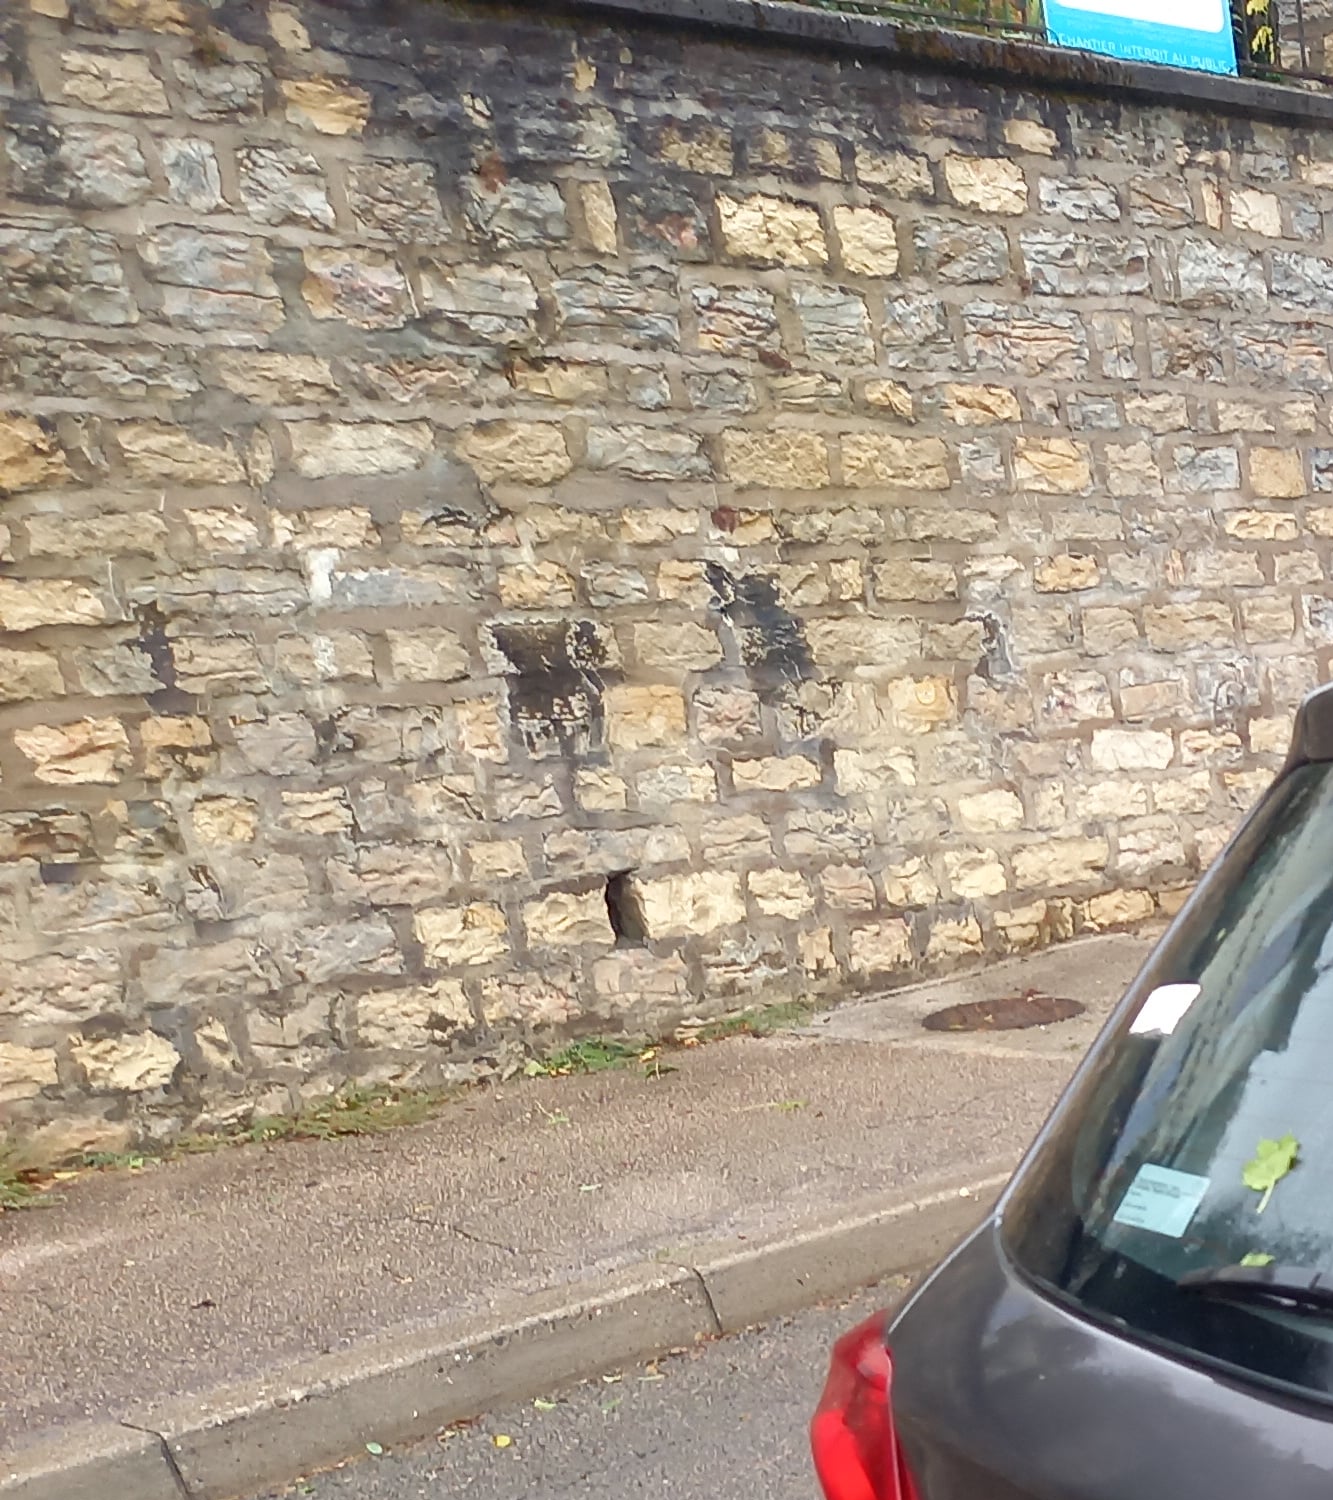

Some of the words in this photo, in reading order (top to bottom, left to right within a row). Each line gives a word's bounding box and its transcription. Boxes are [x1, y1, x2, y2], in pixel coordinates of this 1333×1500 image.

[1059, 33, 1116, 51] CHANTIER
[1119, 44, 1168, 62] INTERDIT
[1172, 52, 1187, 66] AU
